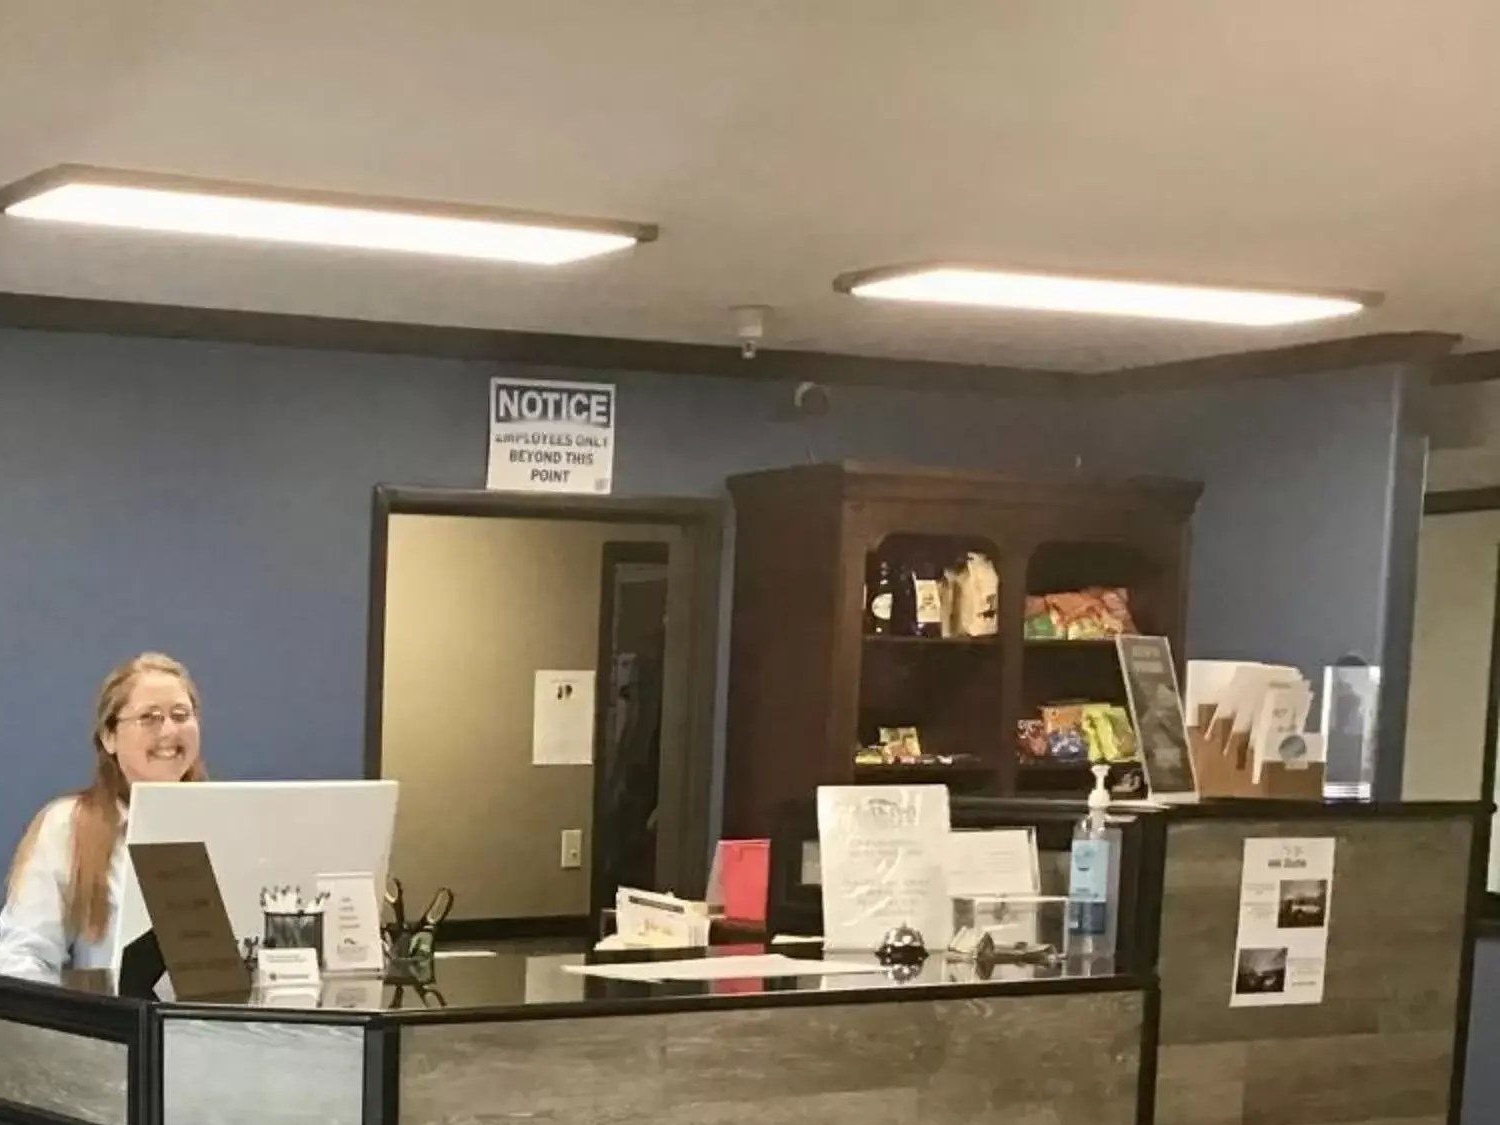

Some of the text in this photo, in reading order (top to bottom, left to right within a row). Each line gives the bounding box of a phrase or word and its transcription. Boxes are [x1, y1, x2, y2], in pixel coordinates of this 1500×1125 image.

[499, 388, 609, 423] NOTICE
[495, 432, 608, 448] EMPLOYEES ONLY
[509, 449, 594, 465] BEYOND THIS
[530, 469, 571, 483] POINT
